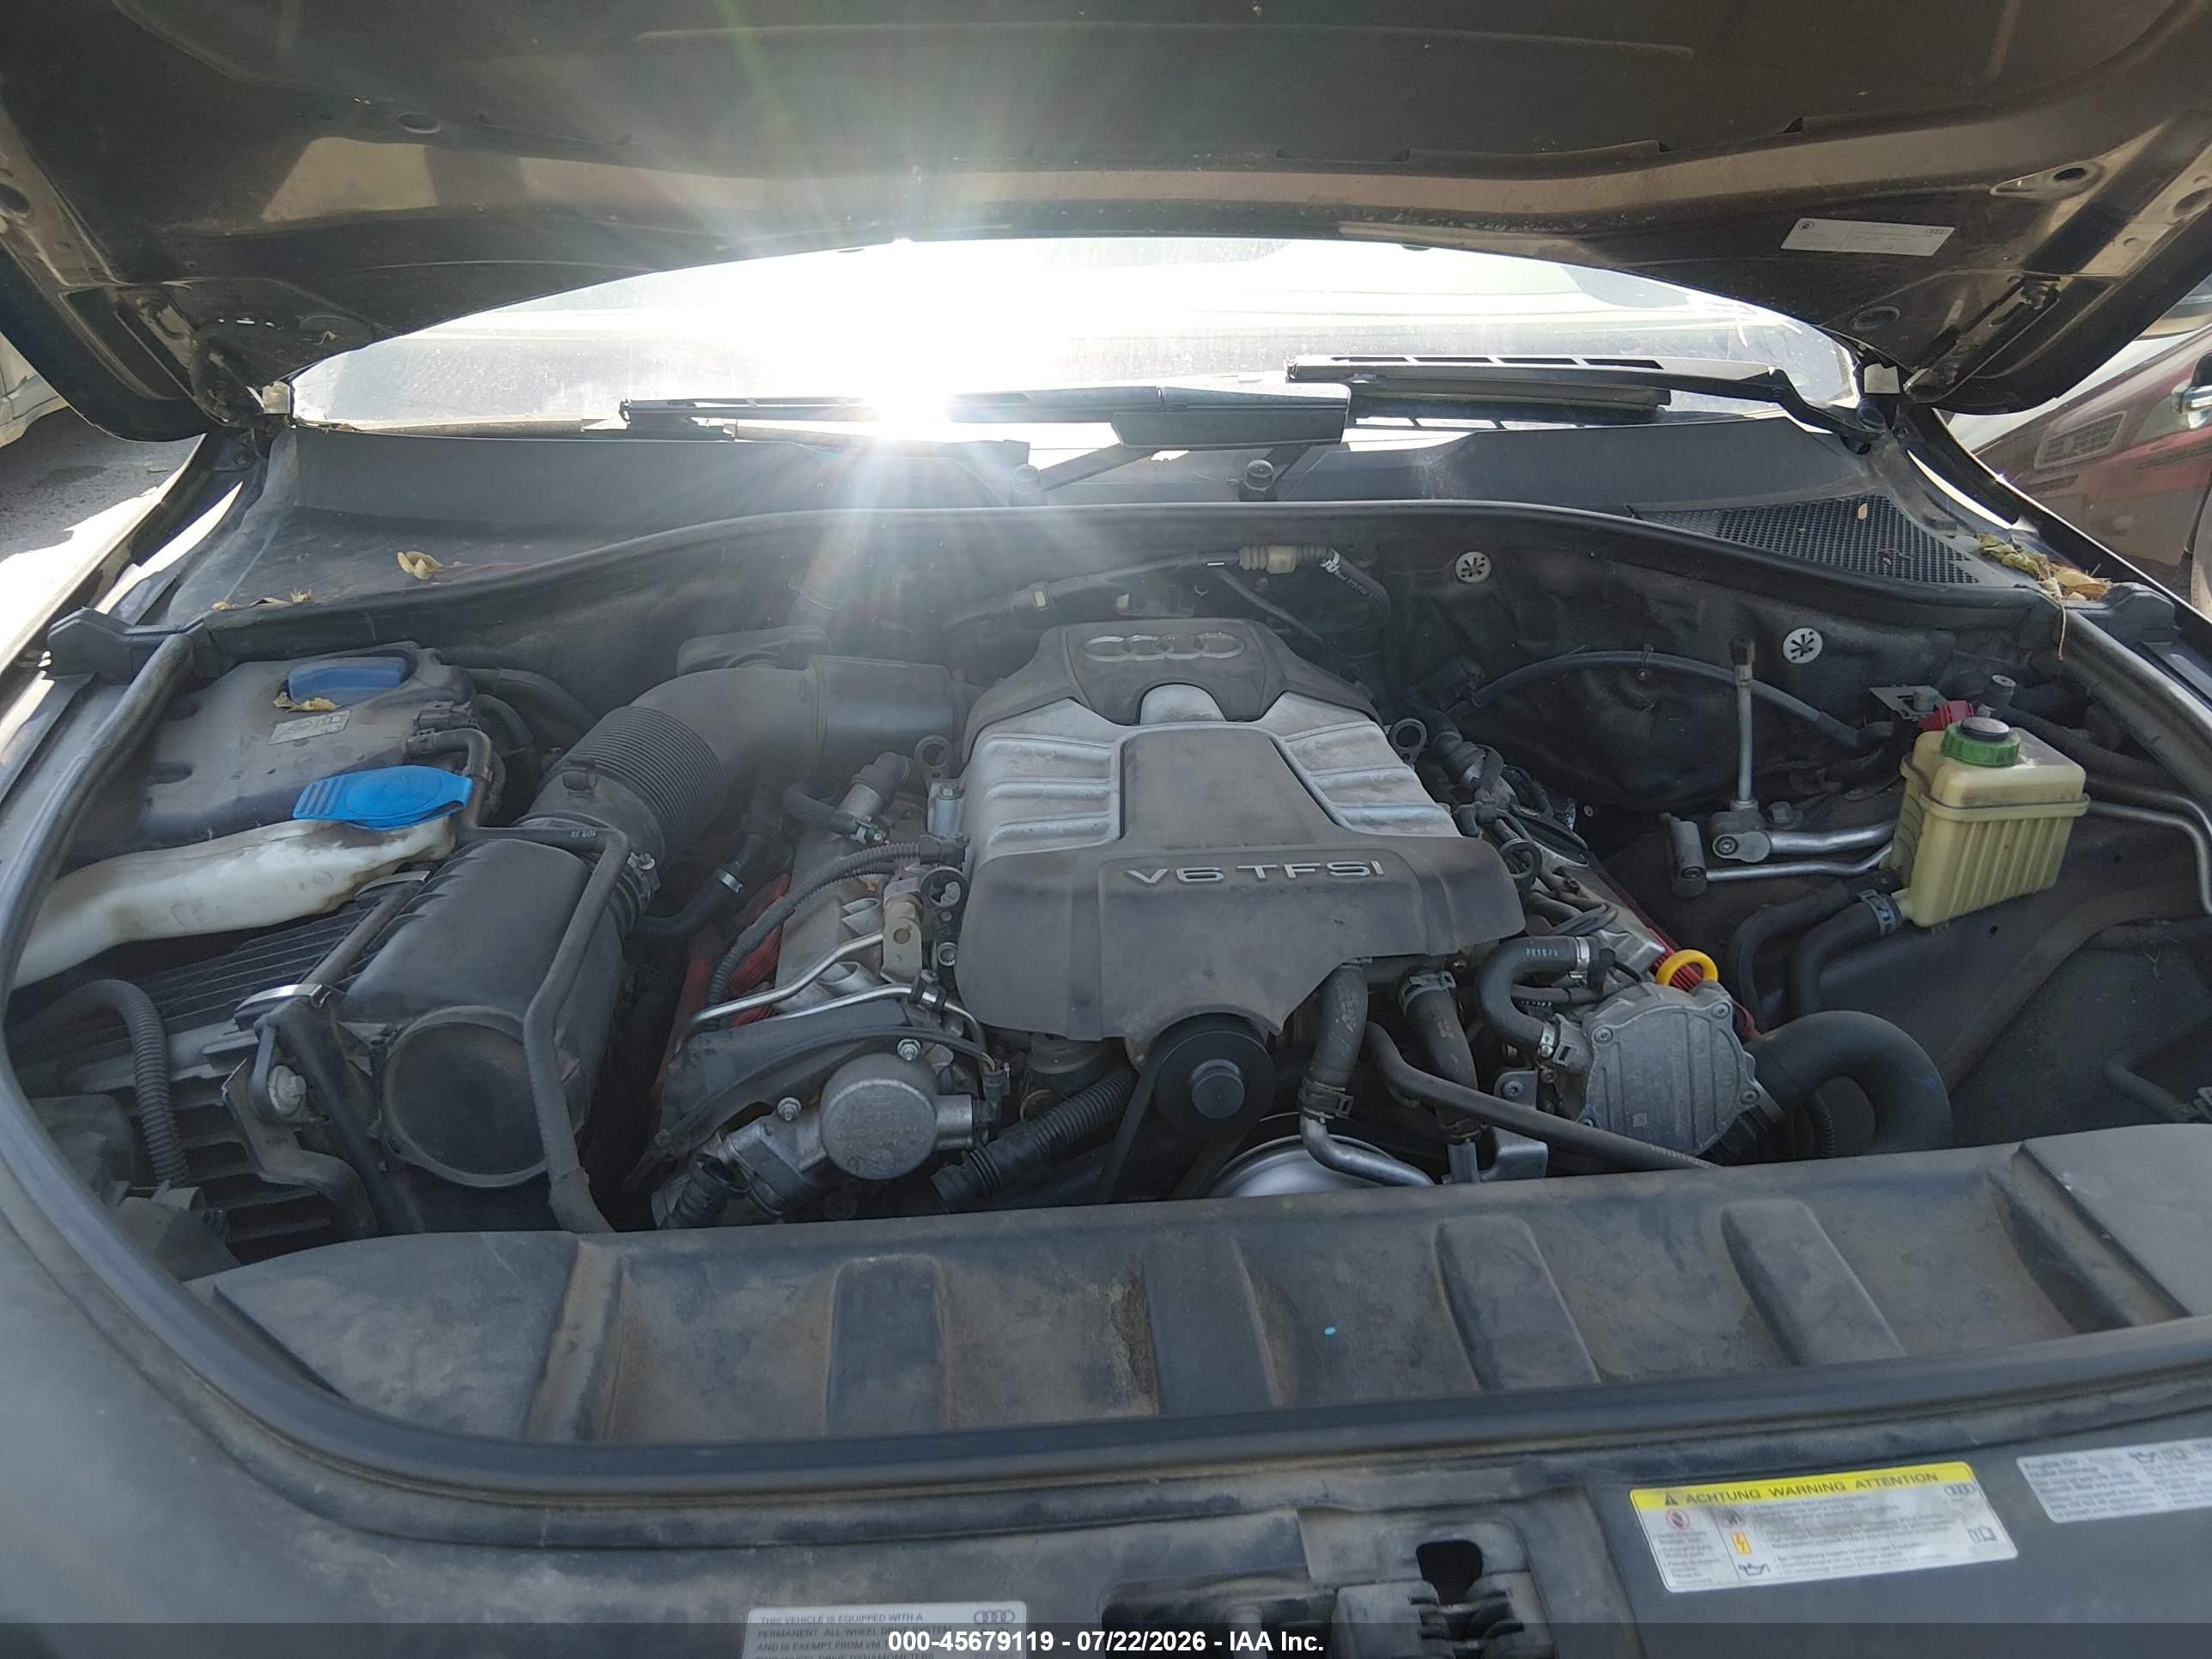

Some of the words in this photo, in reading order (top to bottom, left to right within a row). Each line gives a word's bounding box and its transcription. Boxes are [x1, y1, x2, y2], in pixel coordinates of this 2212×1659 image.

[1126, 866, 1224, 884] V6
[1237, 860, 1385, 879] TFSI
[1686, 1489, 1761, 1504] ACHTUNG
[1768, 1481, 1845, 1498] WARNING
[1855, 1473, 1939, 1490] ATTENTION
[888, 1613, 914, 1622] WITH
[845, 1626, 878, 1636] WHEEL
